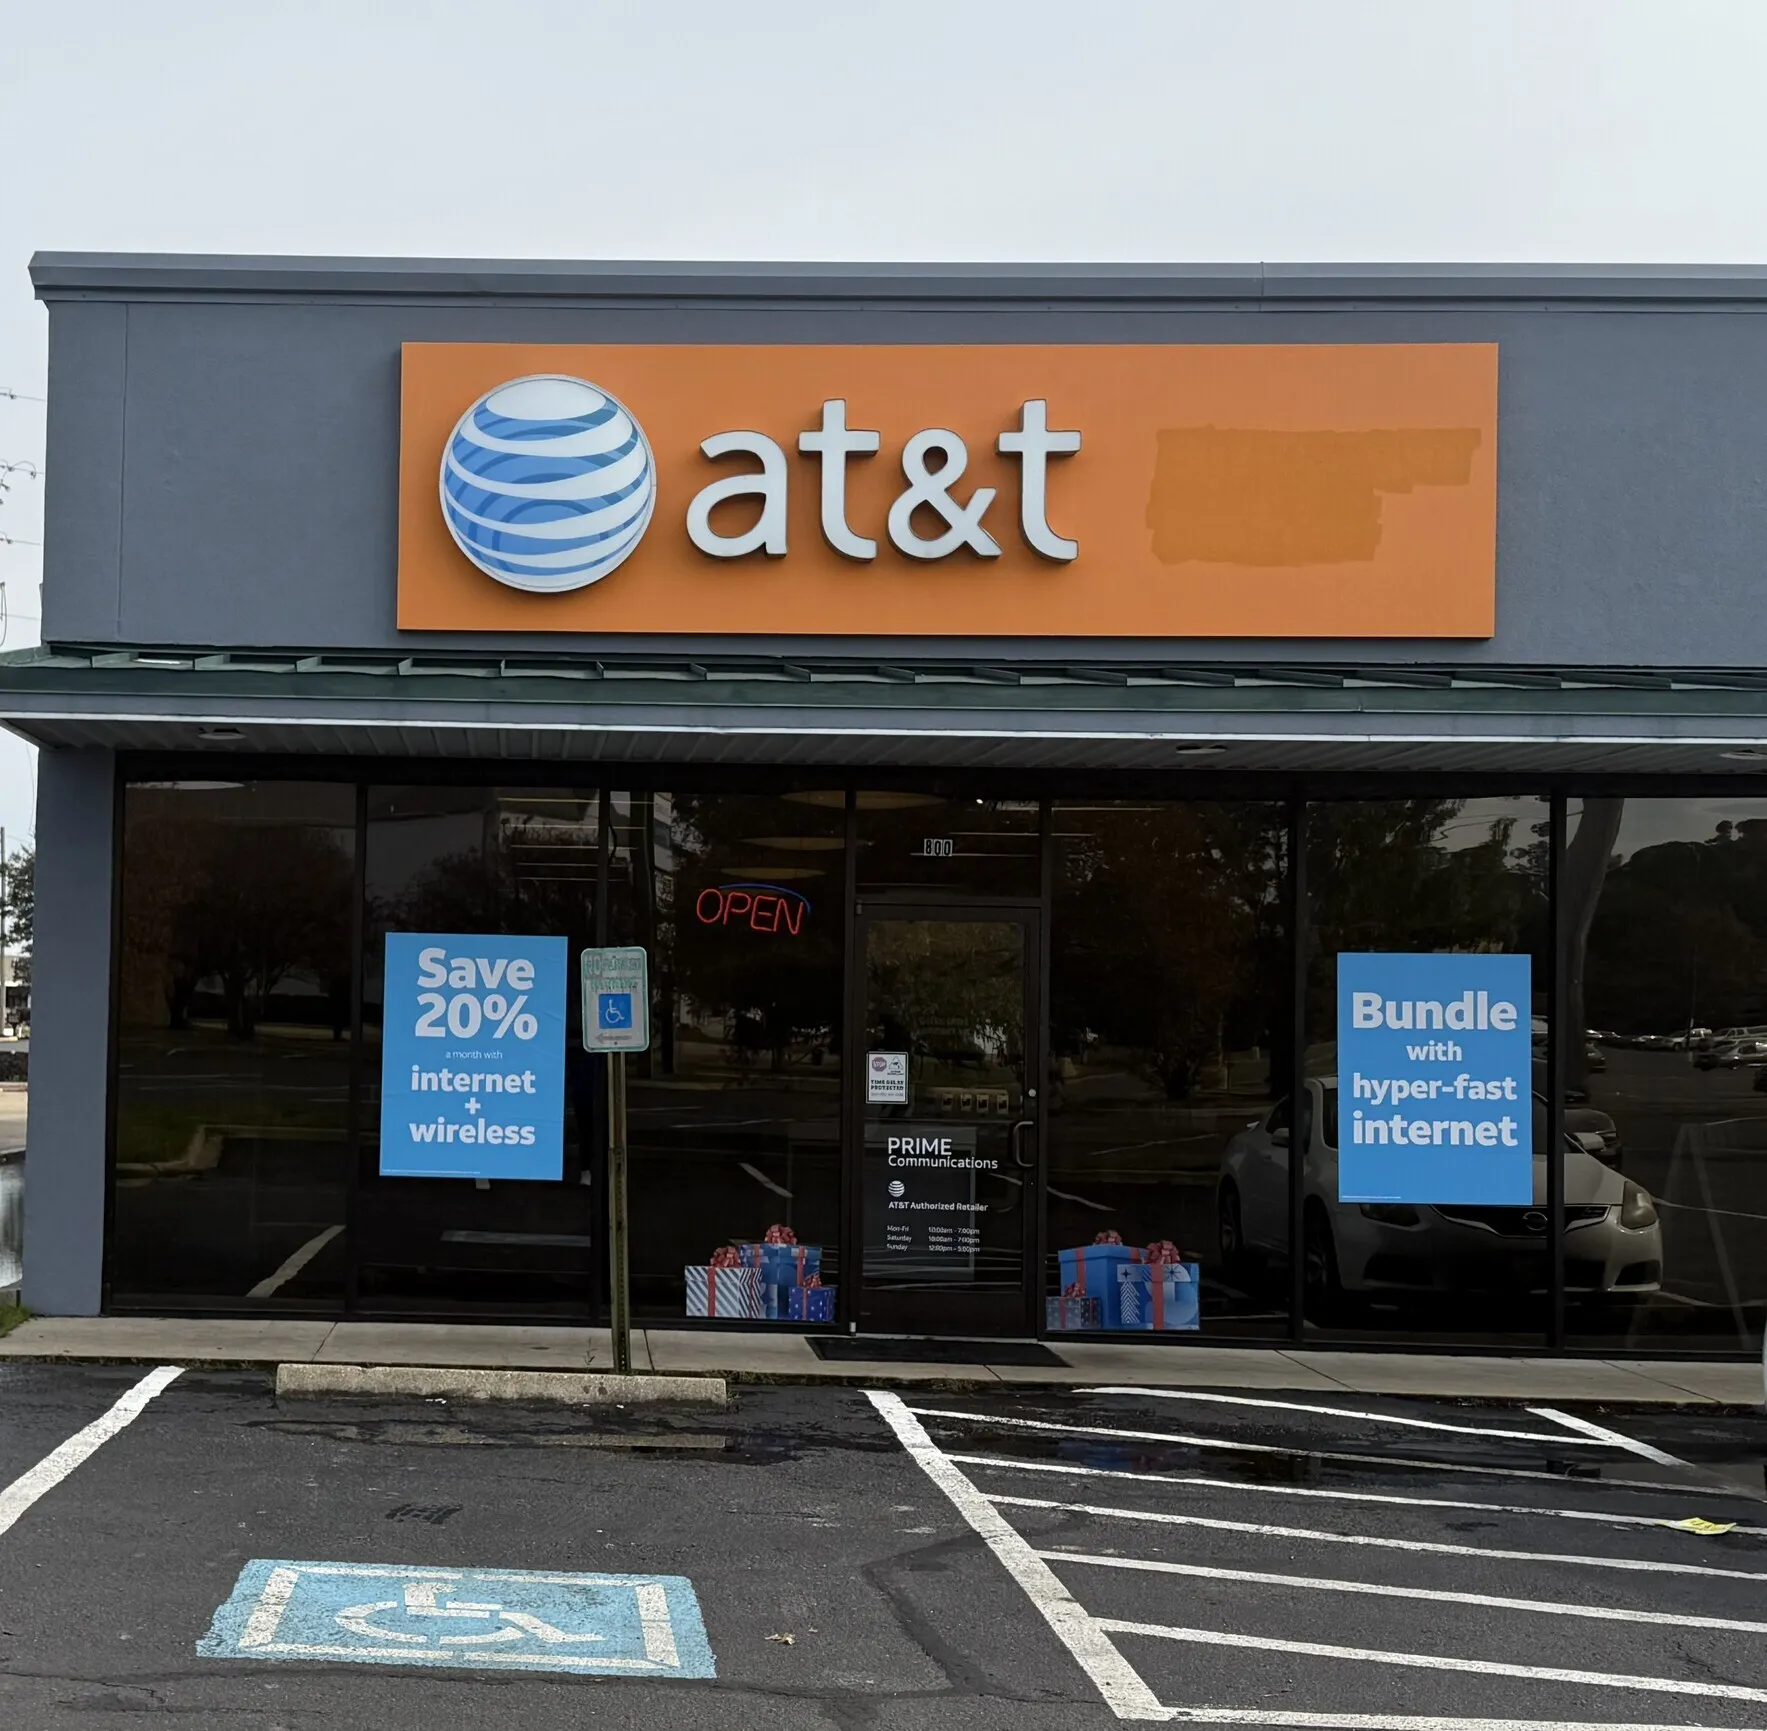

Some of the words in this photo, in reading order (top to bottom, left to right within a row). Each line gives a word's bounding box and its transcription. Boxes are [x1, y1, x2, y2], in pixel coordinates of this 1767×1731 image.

[686, 398, 1082, 562] at&t
[925, 839, 952, 856] 800
[696, 888, 804, 935] OPEN
[416, 947, 535, 990] Save
[415, 992, 538, 1040] 20%
[1352, 991, 1518, 1030] Bundle
[452, 1051, 482, 1059] month
[484, 1051, 503, 1059] with
[1406, 1040, 1463, 1061] with
[411, 1064, 537, 1094] internet
[1352, 1072, 1518, 1105] hyper-fast
[464, 1097, 481, 1115] +
[409, 1116, 536, 1145] wireless
[1352, 1110, 1519, 1147] internet
[887, 1137, 952, 1155] PRIME
[888, 1155, 998, 1169] Communications
[888, 1201, 909, 1209] AT&T
[910, 1202, 955, 1210] Authorized
[956, 1203, 988, 1212] Retailer
[886, 1235, 912, 1243] Saturday
